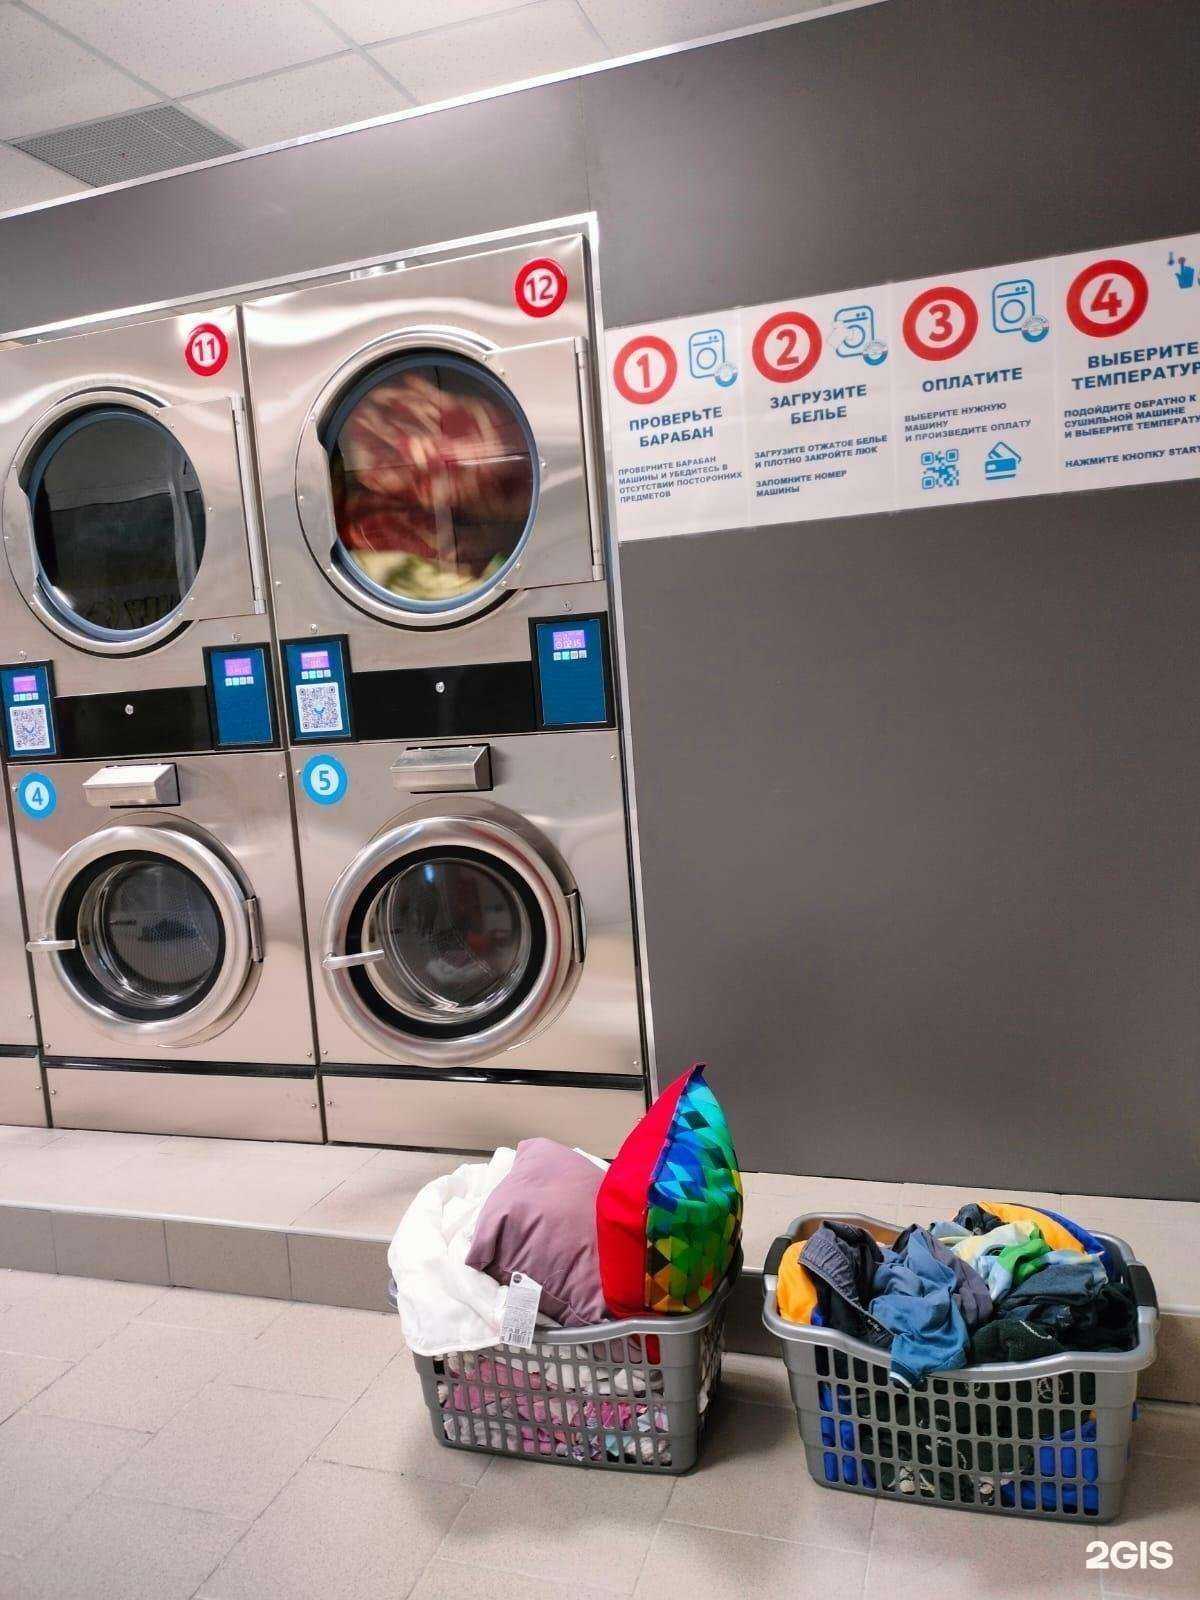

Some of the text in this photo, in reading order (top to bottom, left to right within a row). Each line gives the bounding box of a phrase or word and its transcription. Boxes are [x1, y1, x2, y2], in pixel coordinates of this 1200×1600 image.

[526, 275, 553, 302] 12
[1090, 278, 1122, 317] 4
[928, 303, 953, 342] 3
[195, 338, 215, 361] 11
[775, 328, 800, 366] 2
[1088, 341, 1199, 369] ВЫБЕРИТЕ
[636, 353, 650, 388] 1
[922, 367, 1023, 392] ОПЛАТИТЕ
[770, 384, 867, 409] ЗАГРУЗИТЕ
[1064, 394, 1197, 418] ПОДОЙДИТЕ ОБРАТНО К
[629, 406, 723, 431] ПРОВЕРЬТЕ
[791, 405, 847, 425] БЕЛЬЕ
[904, 402, 1007, 422] ВЫБЕРИТЕ НУЖНУЮ
[1064, 406, 1185, 428] СУШИЛЬНОЙ МАШИНЕ
[639, 426, 713, 447] БАРАБАН
[904, 420, 949, 432] МАШИНУ
[915, 425, 988, 441] ПРОИЗВЕДИТЕ
[990, 419, 1032, 431] ОПЛАТУ
[1064, 431, 1072, 439] И
[1075, 423, 1134, 438] ВЫБЕРИТЕ
[754, 434, 888, 459] ЗАГРУЗИТЕ ОТЖАТОЕ БЕЛЬЕ
[764, 456, 802, 468] ПЛОТНО
[805, 449, 853, 462] ЗАКРОЙТЕ
[855, 446, 878, 456] ЛЮК
[676, 456, 716, 468] БАРАБАН
[1065, 454, 1120, 468] НАЖМИТЕ
[1122, 449, 1166, 461] КНОПКУ
[619, 474, 658, 485] МАШИНЫ
[669, 465, 720, 478] УБЕДИТЕСЬ
[619, 471, 743, 494] ОТСУТСТВИИ ПОСТОРОННИХ
[756, 470, 847, 488] ЗАПОМНИТЕ НОМЕР
[620, 491, 671, 503] ПРЕДМЕТОВ
[756, 485, 800, 497] МАШИНЫ
[318, 770, 331, 791] 5
[32, 787, 42, 806] 4
